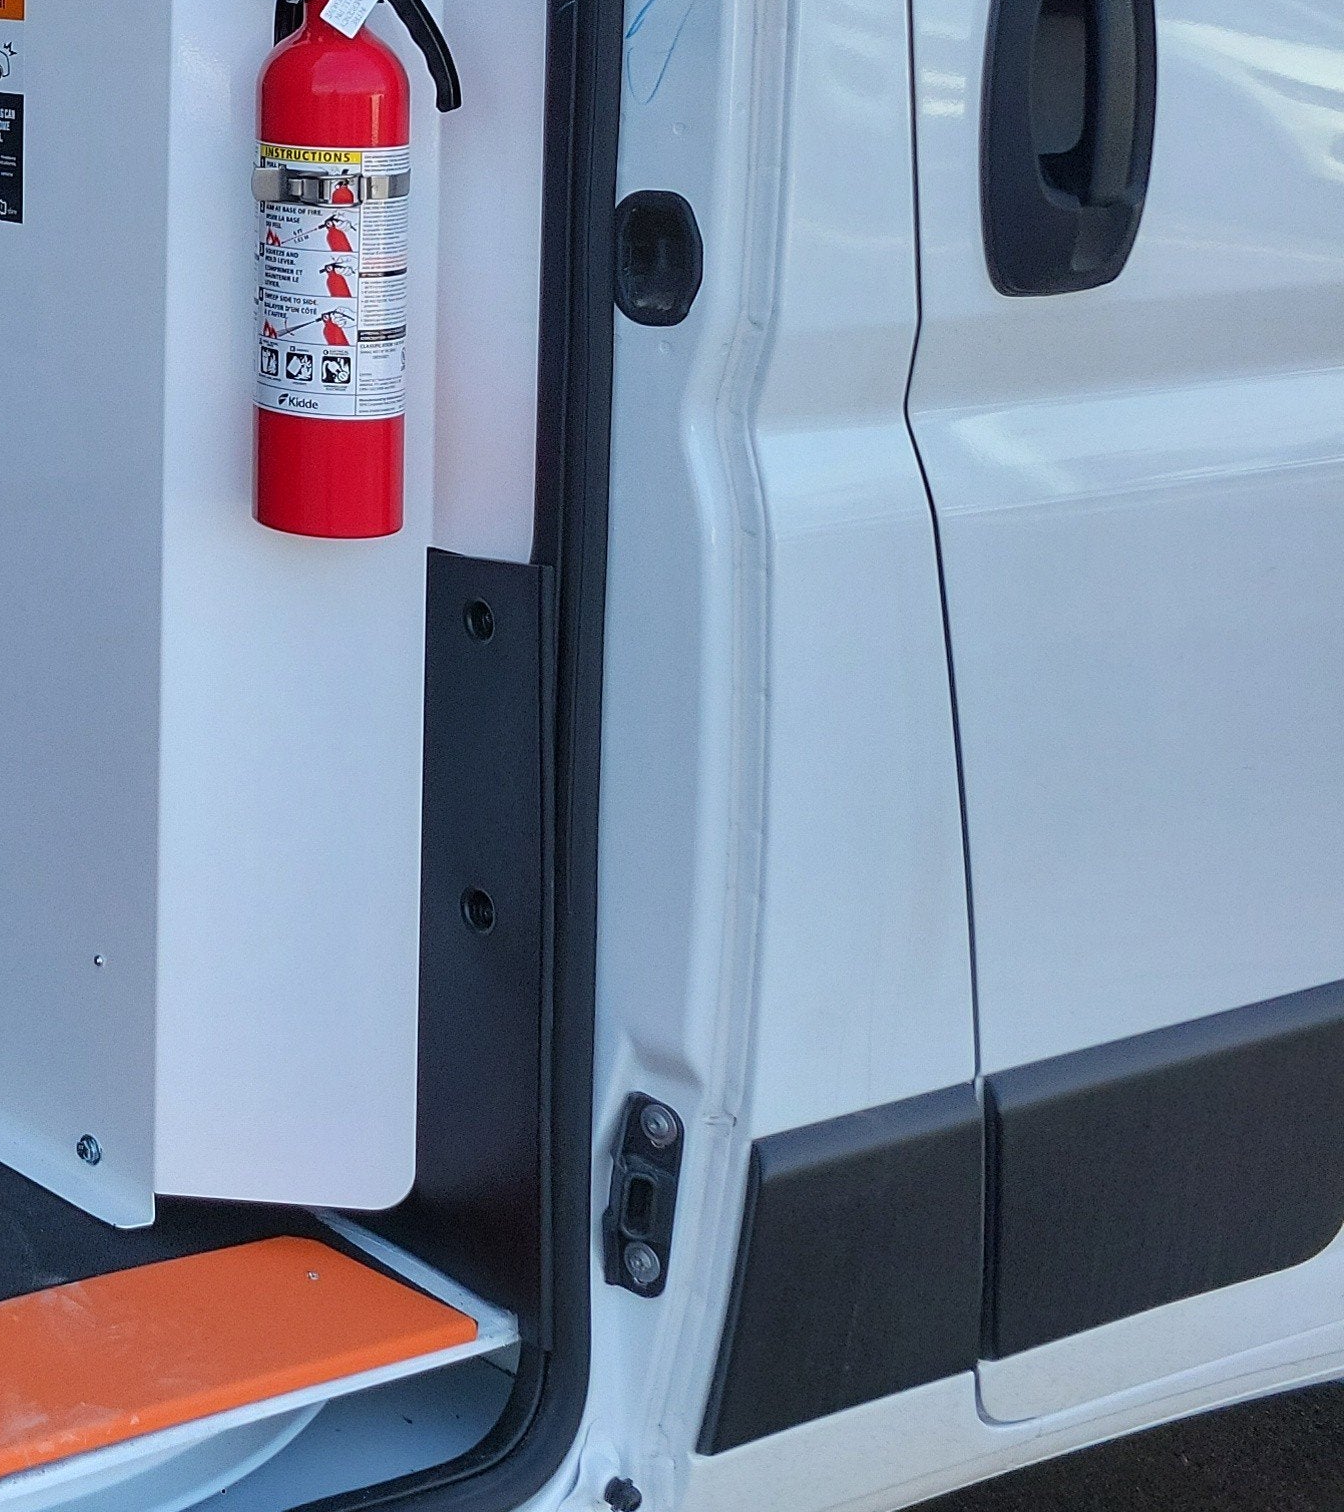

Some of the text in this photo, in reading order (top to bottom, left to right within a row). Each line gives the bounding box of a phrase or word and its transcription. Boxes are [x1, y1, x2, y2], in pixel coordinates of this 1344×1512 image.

[265, 147, 350, 162] INSTRUCTIONS
[282, 205, 296, 213] BASE
[286, 250, 299, 258] AND
[265, 255, 276, 263] HOLD
[292, 275, 299, 283] LE
[265, 292, 279, 301] SWEEP
[280, 295, 292, 303] SIDE
[301, 306, 317, 315] CÔTÉ
[288, 396, 319, 409] Kidde
